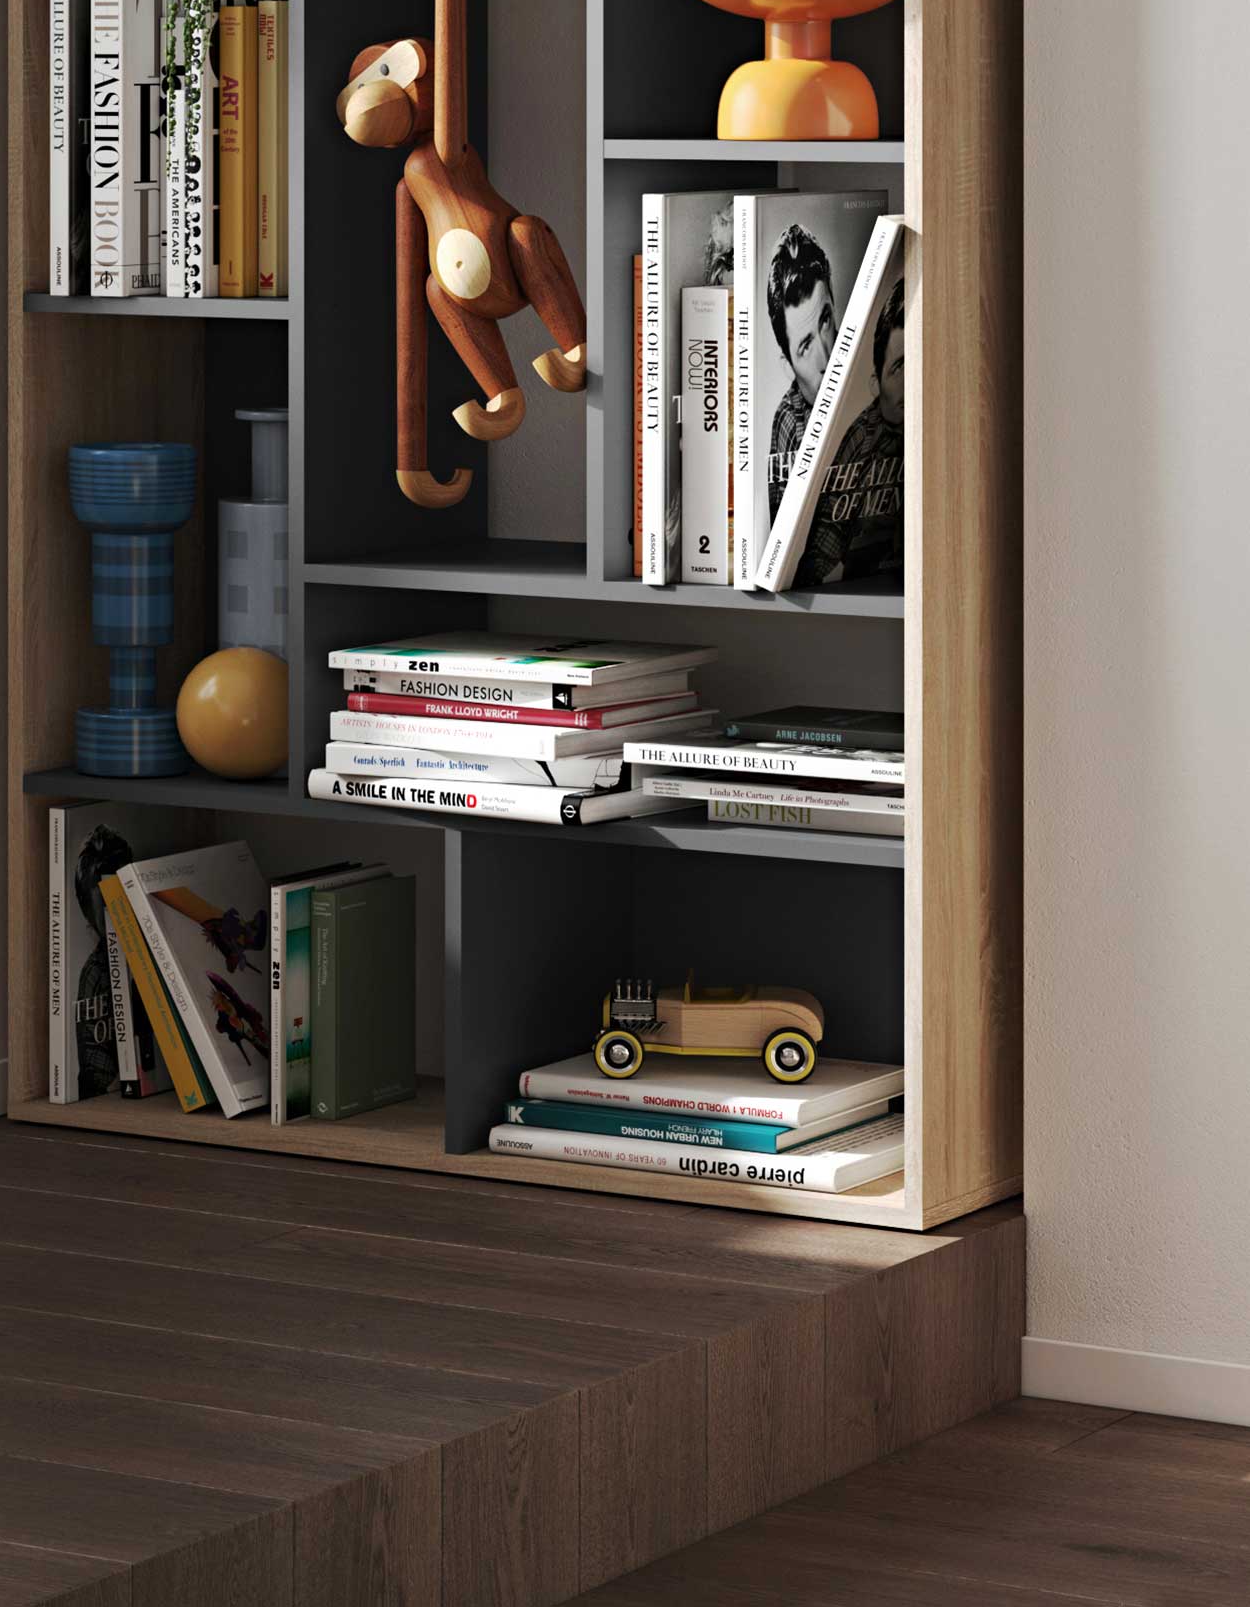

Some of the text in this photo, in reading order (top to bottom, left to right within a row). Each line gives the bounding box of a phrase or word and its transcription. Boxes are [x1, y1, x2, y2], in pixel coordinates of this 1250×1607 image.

[53, 58, 64, 82] OF
[222, 74, 239, 120] ART
[53, 84, 64, 153] BEAUTY
[94, 52, 119, 192] FASHION
[171, 158, 179, 266] THE AMERICANS
[647, 217, 659, 433] THE ALLURE OF BEAUTY
[688, 338, 703, 390] NOW!
[703, 339, 718, 432] INTERIORS
[739, 307, 749, 472] THE ALLURE OF MEN
[796, 325, 857, 480] THE ALLURE OF MEN
[822, 455, 904, 493] THE ALLU
[832, 494, 860, 522] OF
[699, 535, 710, 554] 2
[764, 538, 782, 579] ASSOULINE
[408, 660, 440, 672] zen
[400, 680, 513, 702] FASHION DESIGN
[426, 704, 519, 720] FRANK LLOYD WRIGHT
[407, 724, 416, 732] IN
[418, 726, 451, 735] LONDON
[776, 730, 842, 743] ARNE JACOBSEN
[416, 759, 489, 772] Fantastic Architecture
[639, 748, 797, 772] THE ALLURE OF BEAUTY
[871, 769, 903, 777] ASSOULINE
[332, 780, 342, 795] A
[346, 782, 387, 799] SMILE
[391, 787, 406, 801] IN
[410, 788, 435, 805] THE
[439, 792, 477, 809] MIND
[710, 787, 731, 797] Linda
[781, 794, 793, 802] Life
[805, 795, 850, 807] Photographs
[714, 800, 811, 824] LOST FISH
[53, 892, 61, 1016] THE ALLURE OF MEN
[108, 932, 127, 1042] FASHION DESIGN
[74, 993, 110, 1023] THE
[643, 1095, 783, 1120] FORMULA 1 WORLD CHAMPIONS
[621, 1126, 723, 1146] NEW URBAN HOUSING
[668, 1124, 723, 1135] HILARY FRENCH
[496, 1138, 533, 1150] ASSOULINE
[563, 1145, 667, 1166] 60 YEARS OF INNOVATION
[679, 1157, 805, 1188] pierre cardin
